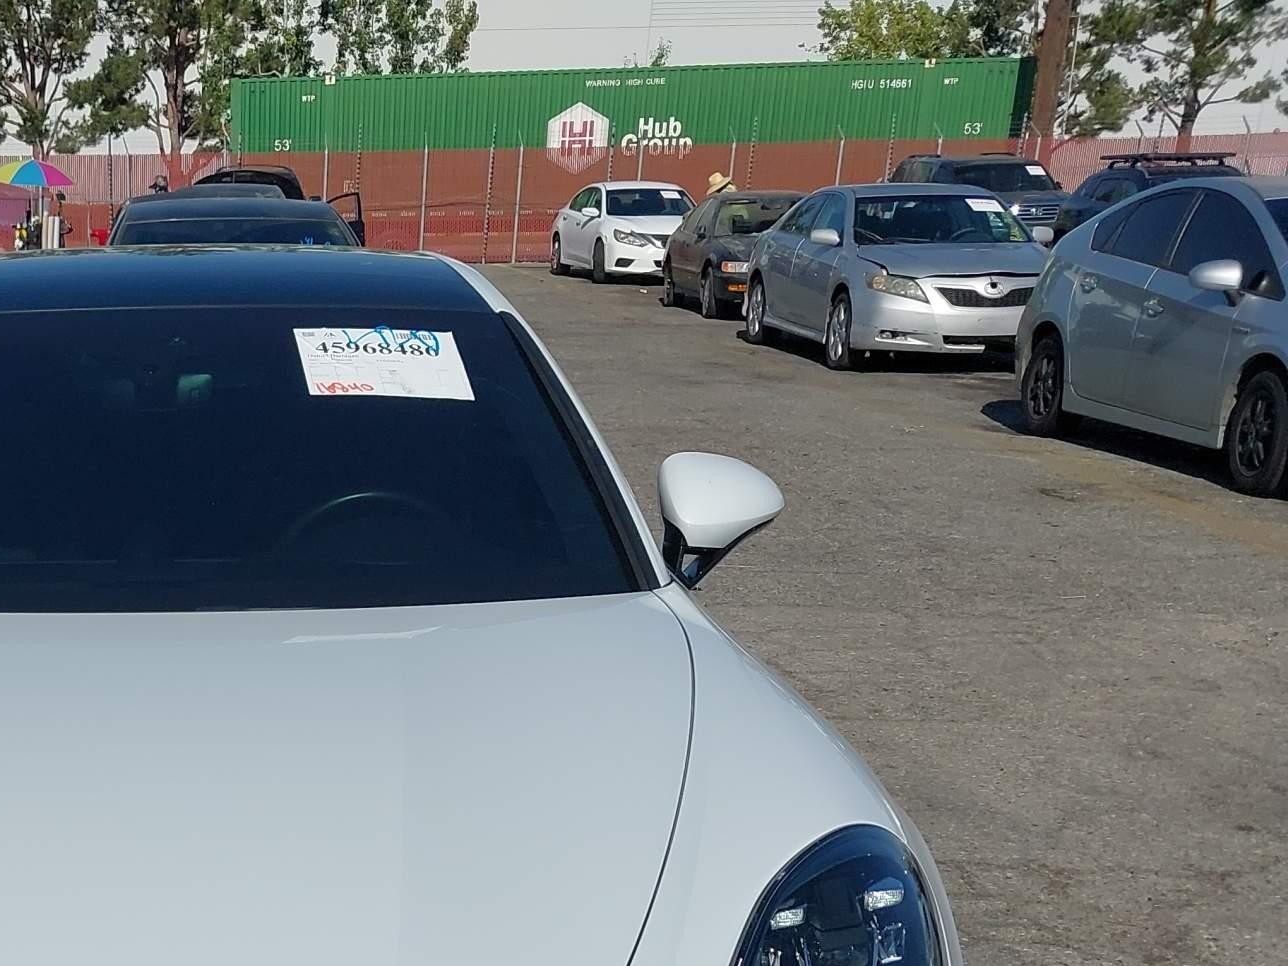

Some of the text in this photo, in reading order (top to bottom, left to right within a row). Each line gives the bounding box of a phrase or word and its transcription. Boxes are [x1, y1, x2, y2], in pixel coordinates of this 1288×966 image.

[585, 77, 666, 88] WARNING HIGH CUBE
[851, 79, 912, 90] HGIU 514661
[638, 116, 682, 138] Hub
[621, 133, 693, 160] Group
